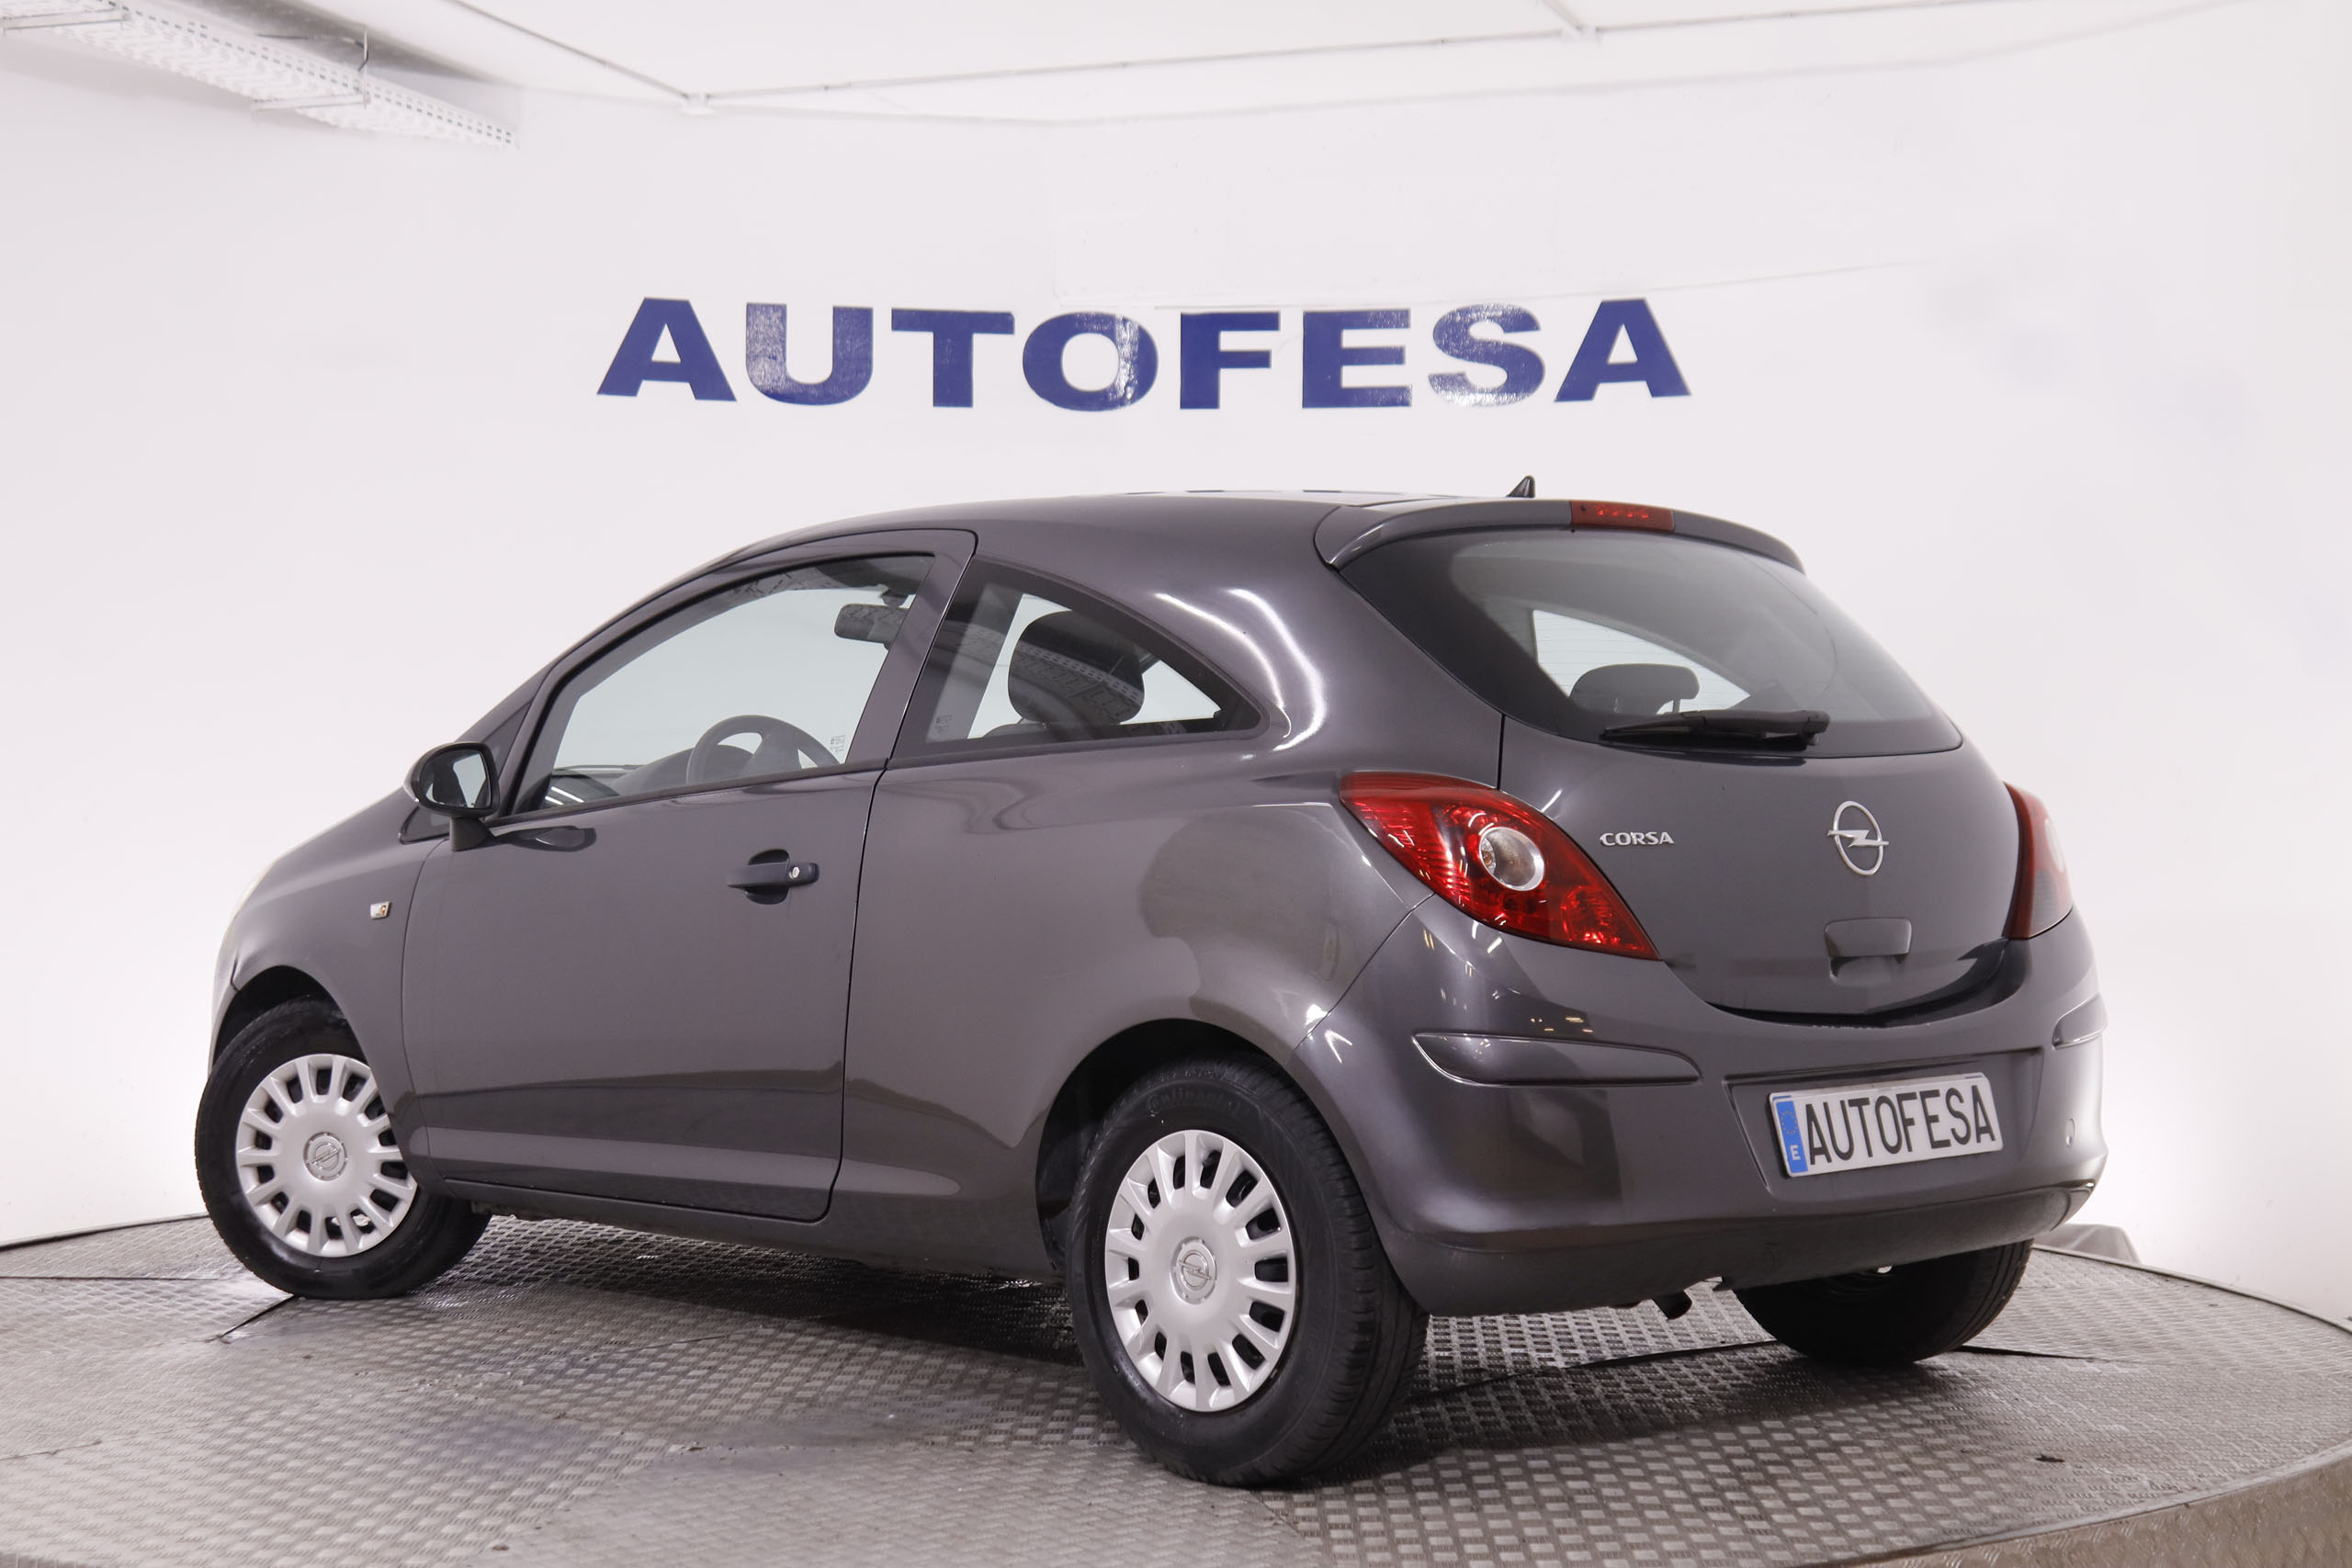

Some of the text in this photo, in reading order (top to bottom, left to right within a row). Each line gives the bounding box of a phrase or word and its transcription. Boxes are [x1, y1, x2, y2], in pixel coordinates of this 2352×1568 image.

[597, 297, 1692, 411] AUTOFESA
[1600, 831, 1674, 846] CORSA
[1805, 1085, 1996, 1165] AUTOFESA
[1791, 1145, 1801, 1160] E
